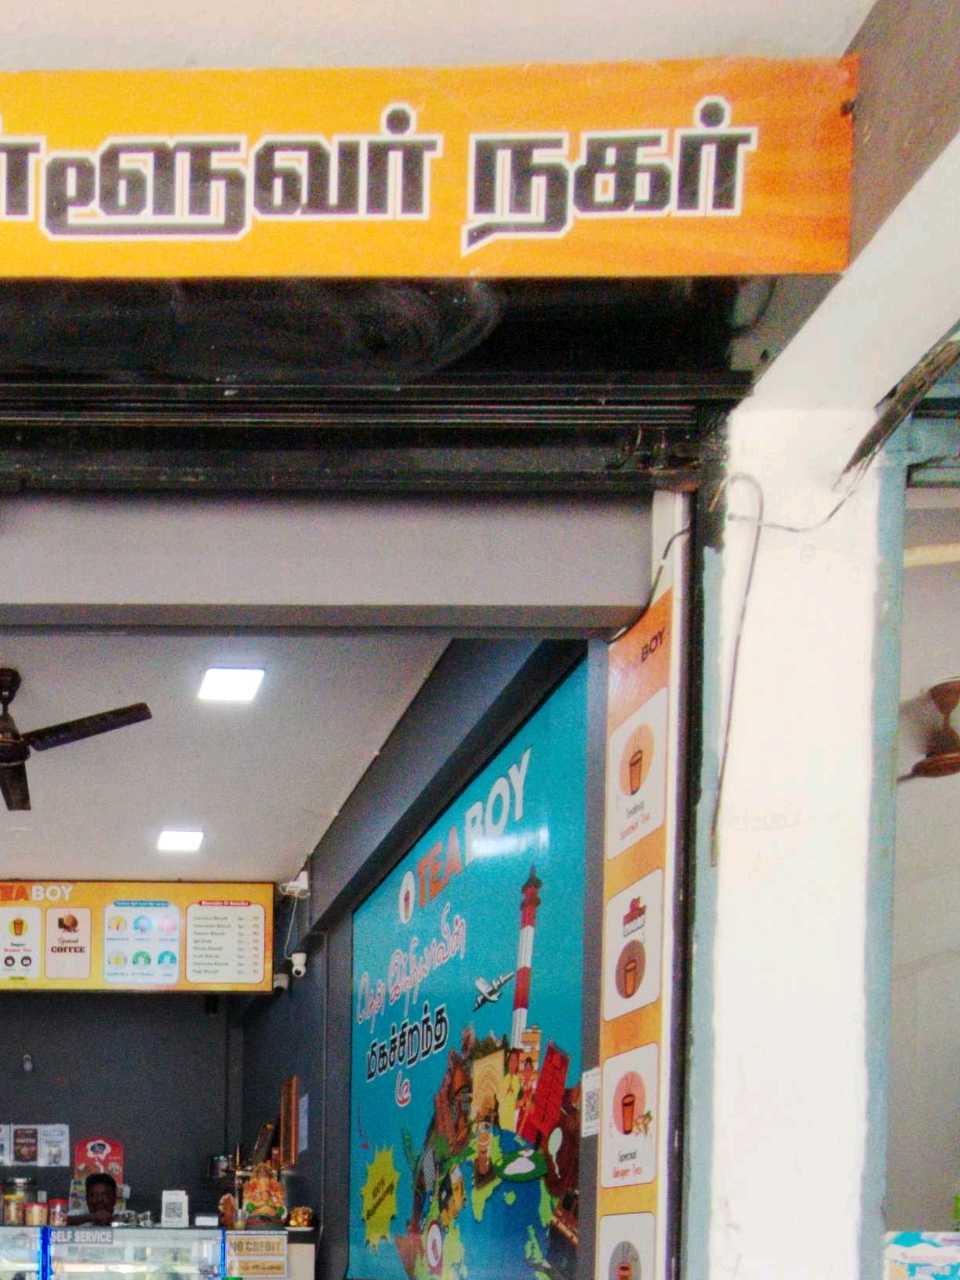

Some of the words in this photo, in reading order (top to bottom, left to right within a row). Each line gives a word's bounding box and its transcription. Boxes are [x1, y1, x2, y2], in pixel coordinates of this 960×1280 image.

[459, 95, 758, 254] நகர்
[640, 628, 666, 663] BOY
[417, 824, 463, 909] TEA
[465, 747, 533, 868] BOY
[31, 885, 74, 902] BOY
[50, 946, 86, 954] COFFEE
[366, 1000, 449, 1082] மிகச்சிறந்த
[52, 1231, 72, 1242] SELF
[74, 1231, 112, 1242] SERVICE
